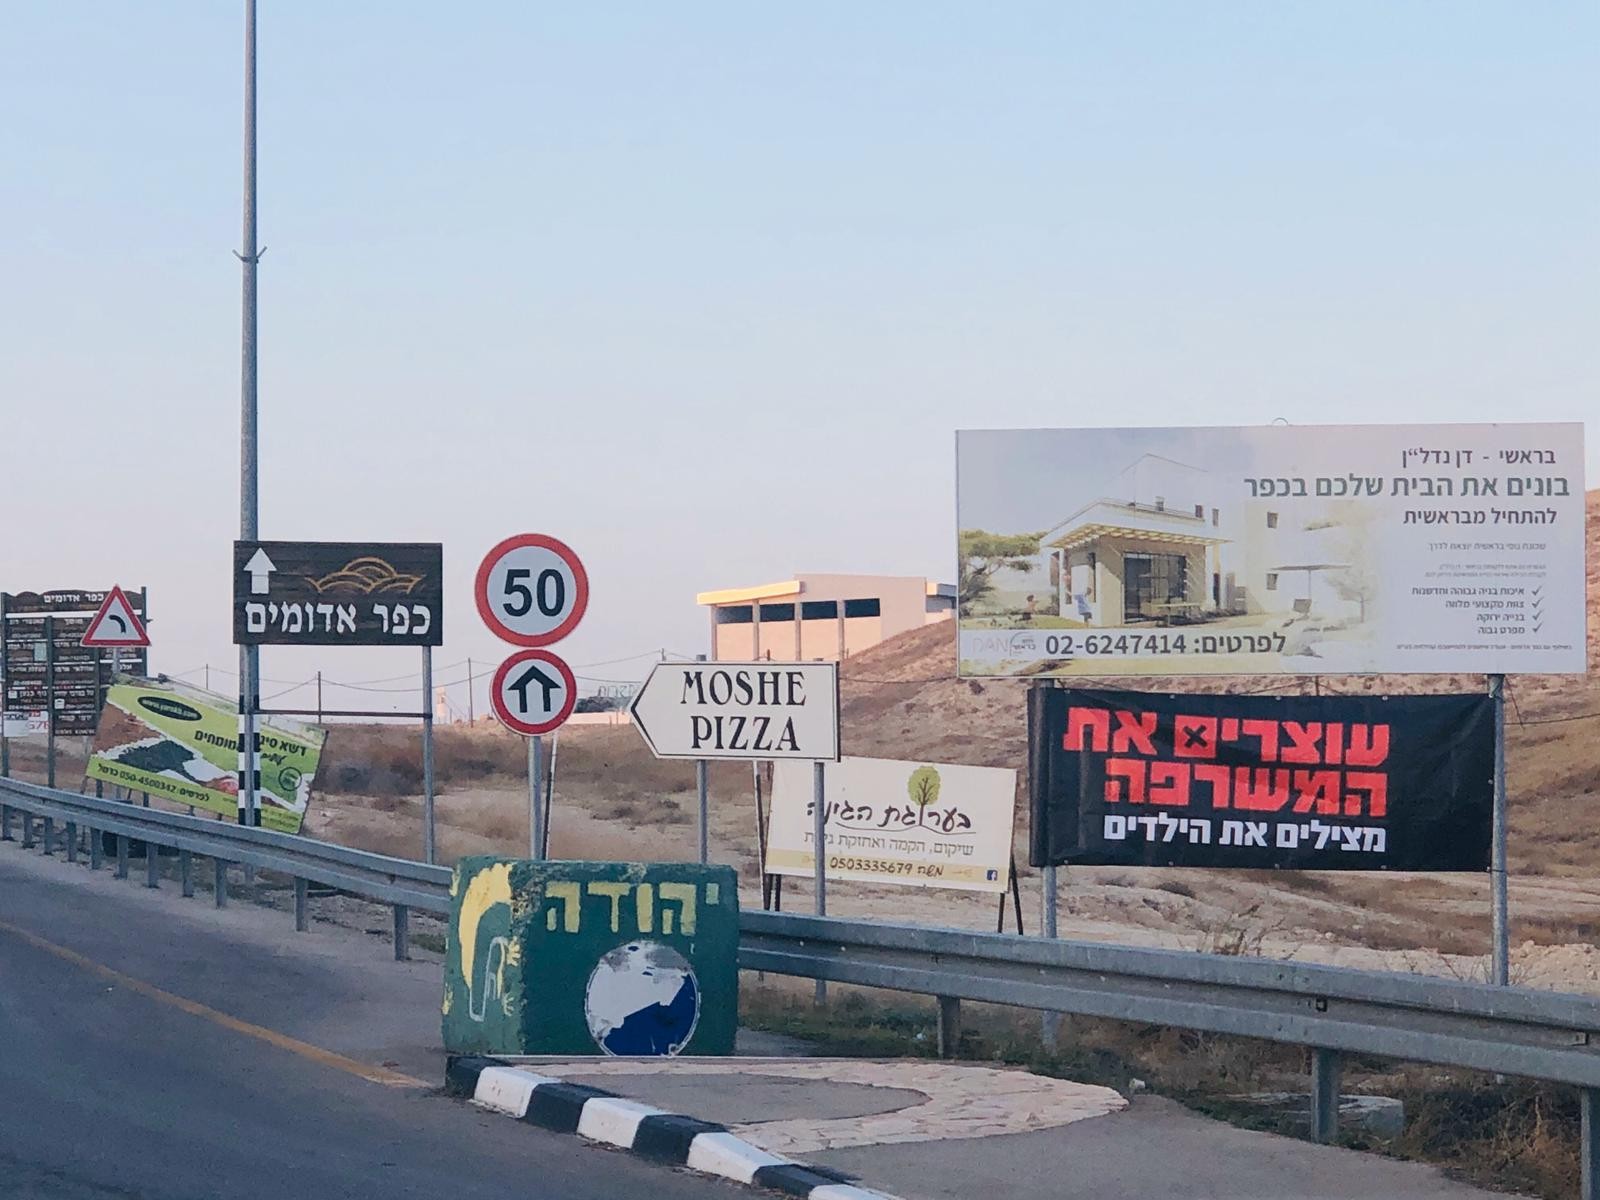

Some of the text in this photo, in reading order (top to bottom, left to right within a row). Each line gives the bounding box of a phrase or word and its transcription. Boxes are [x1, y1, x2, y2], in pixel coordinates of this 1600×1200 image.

[1456, 449, 1473, 470] דן
[1499, 448, 1556, 465] בראשי
[1244, 472, 1570, 498] בונים את הבית שלכם בכפר
[1403, 507, 1558, 525] להתחיל מבראשית
[501, 568, 566, 617] 50
[244, 600, 431, 635] כפר אדומים
[1045, 631, 1286, 656] לפרטים: 02-6247414
[680, 670, 807, 706] MOSHE
[279, 739, 308, 757] דשא
[689, 715, 801, 751] PIZZA
[1062, 706, 1391, 767] עוצרים את
[1104, 757, 1388, 817] המשרפה
[889, 838, 925, 854] הקמה
[1104, 811, 1387, 853] מצילים את הילדים
[829, 856, 945, 878] משה 0503335679
[544, 881, 720, 936] יהודה
